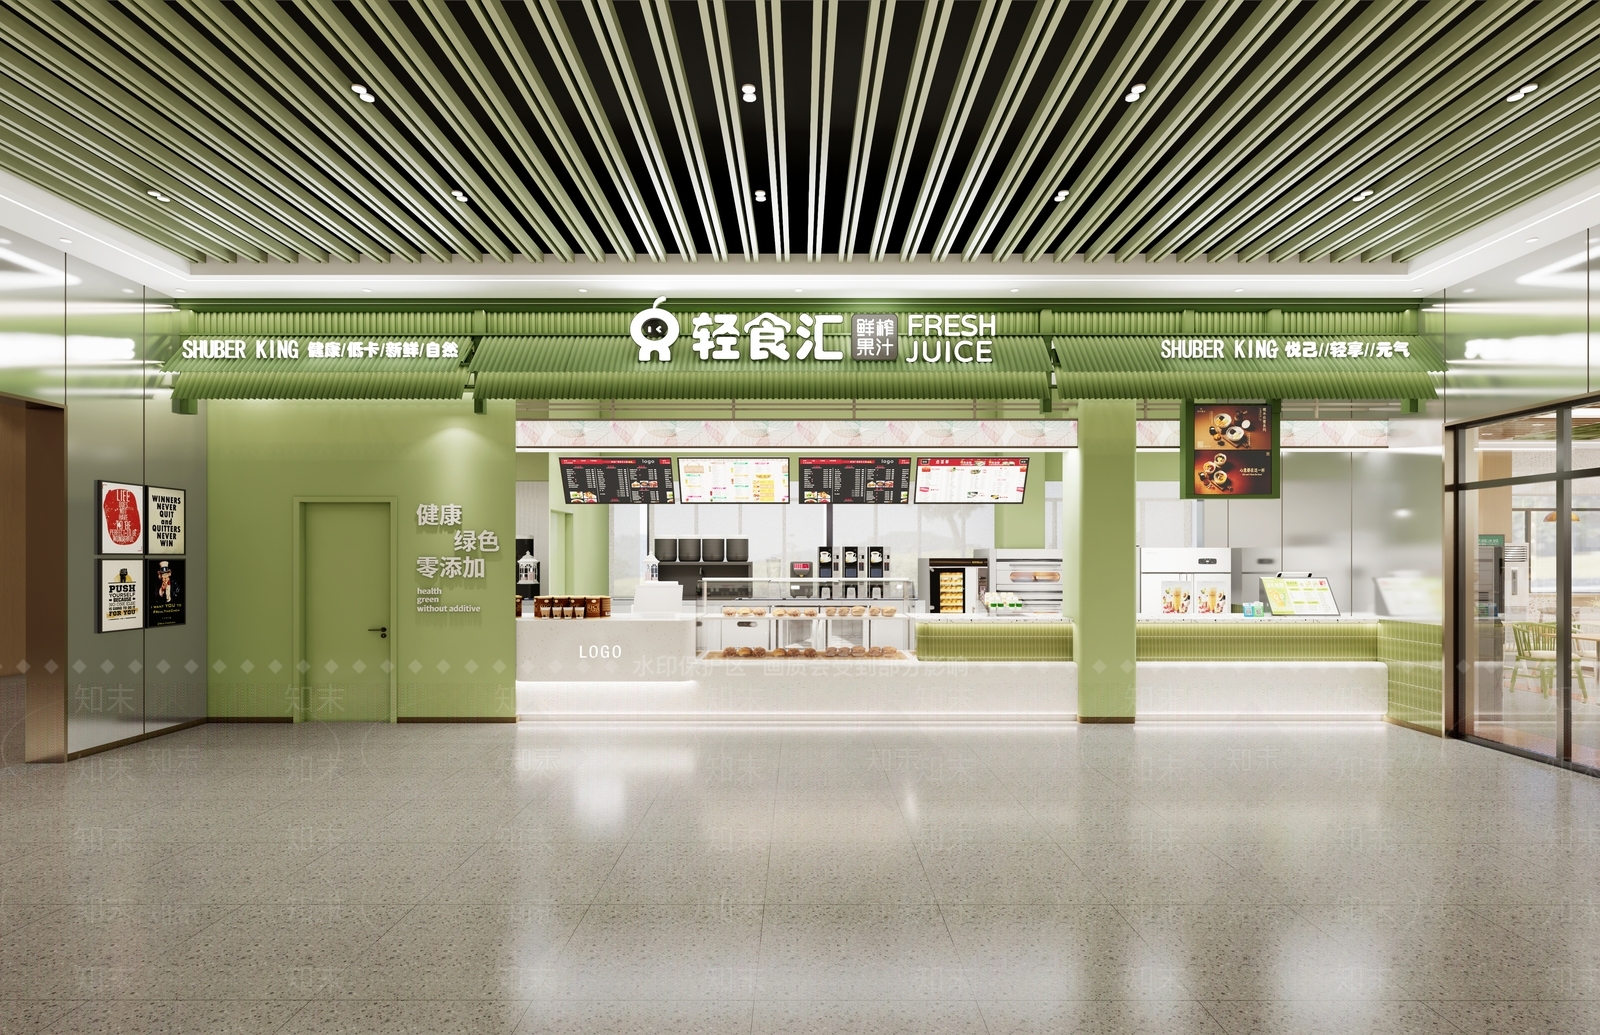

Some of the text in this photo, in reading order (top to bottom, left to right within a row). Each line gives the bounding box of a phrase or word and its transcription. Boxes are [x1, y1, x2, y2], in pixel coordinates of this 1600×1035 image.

[856, 318, 895, 337] 鲜榨
[907, 314, 996, 337] FRESH
[692, 312, 844, 361] 轻食汇
[182, 340, 459, 359] SHUBER KING 健康/低卡/新鲜/自然
[856, 338, 895, 356] 果汁
[905, 340, 993, 363] JUICE
[1160, 340, 1225, 359] SHUBER
[1234, 340, 1278, 359] KING
[116, 489, 131, 502] LIFE
[151, 495, 181, 504] WINNERS
[156, 503, 177, 511] NEVER
[159, 510, 174, 518] QUIT
[416, 503, 462, 526] 健康
[151, 525, 181, 533] QUITTERS
[453, 529, 500, 552] 绿色
[416, 556, 485, 578] 零添加
[108, 585, 136, 593] PUSH
[416, 587, 442, 595] health
[579, 645, 622, 659] LOGO
